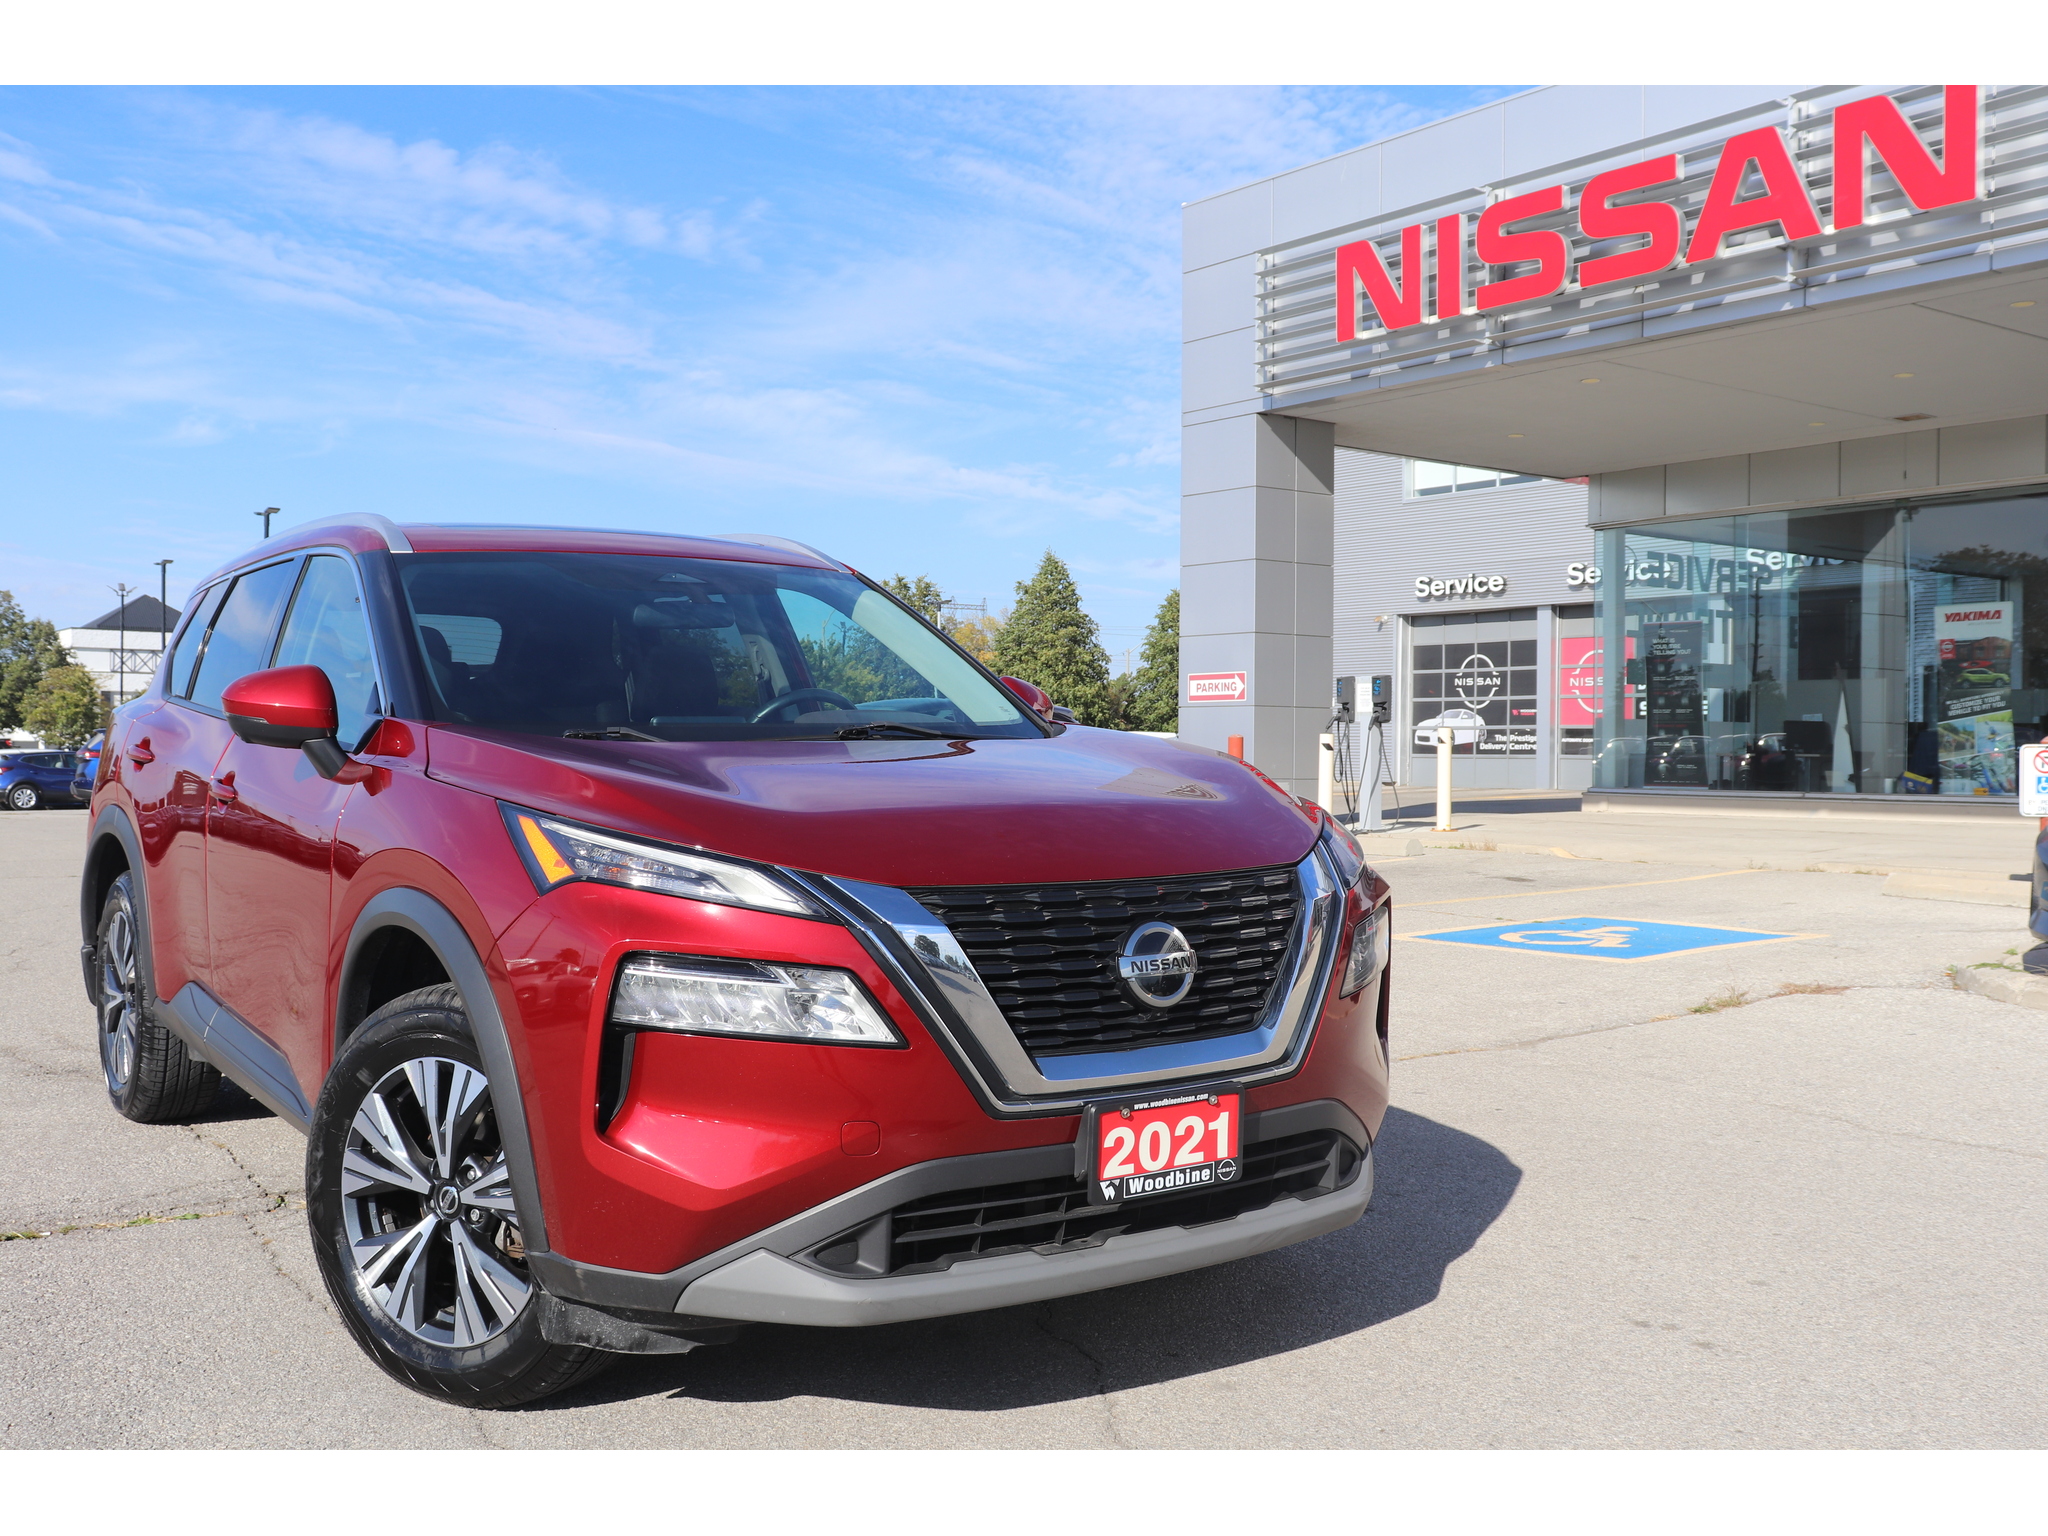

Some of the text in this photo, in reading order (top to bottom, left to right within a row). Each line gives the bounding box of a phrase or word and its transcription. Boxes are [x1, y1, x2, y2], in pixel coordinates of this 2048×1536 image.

[1336, 85, 1978, 343] NISSAN
[1566, 559, 1672, 586] Seice
[1415, 574, 1505, 597] Service
[1945, 610, 2002, 622] YAKIMA
[1196, 682, 1237, 692] PARKING
[1454, 677, 1501, 686] NISSAN
[1479, 743, 1507, 751] Delivery
[1130, 956, 1191, 973] NISSAN
[1134, 1093, 1209, 1110] www.woodbinenissan.com
[1103, 1111, 1230, 1179] 2021
[1129, 1168, 1211, 1194] Woodbine
